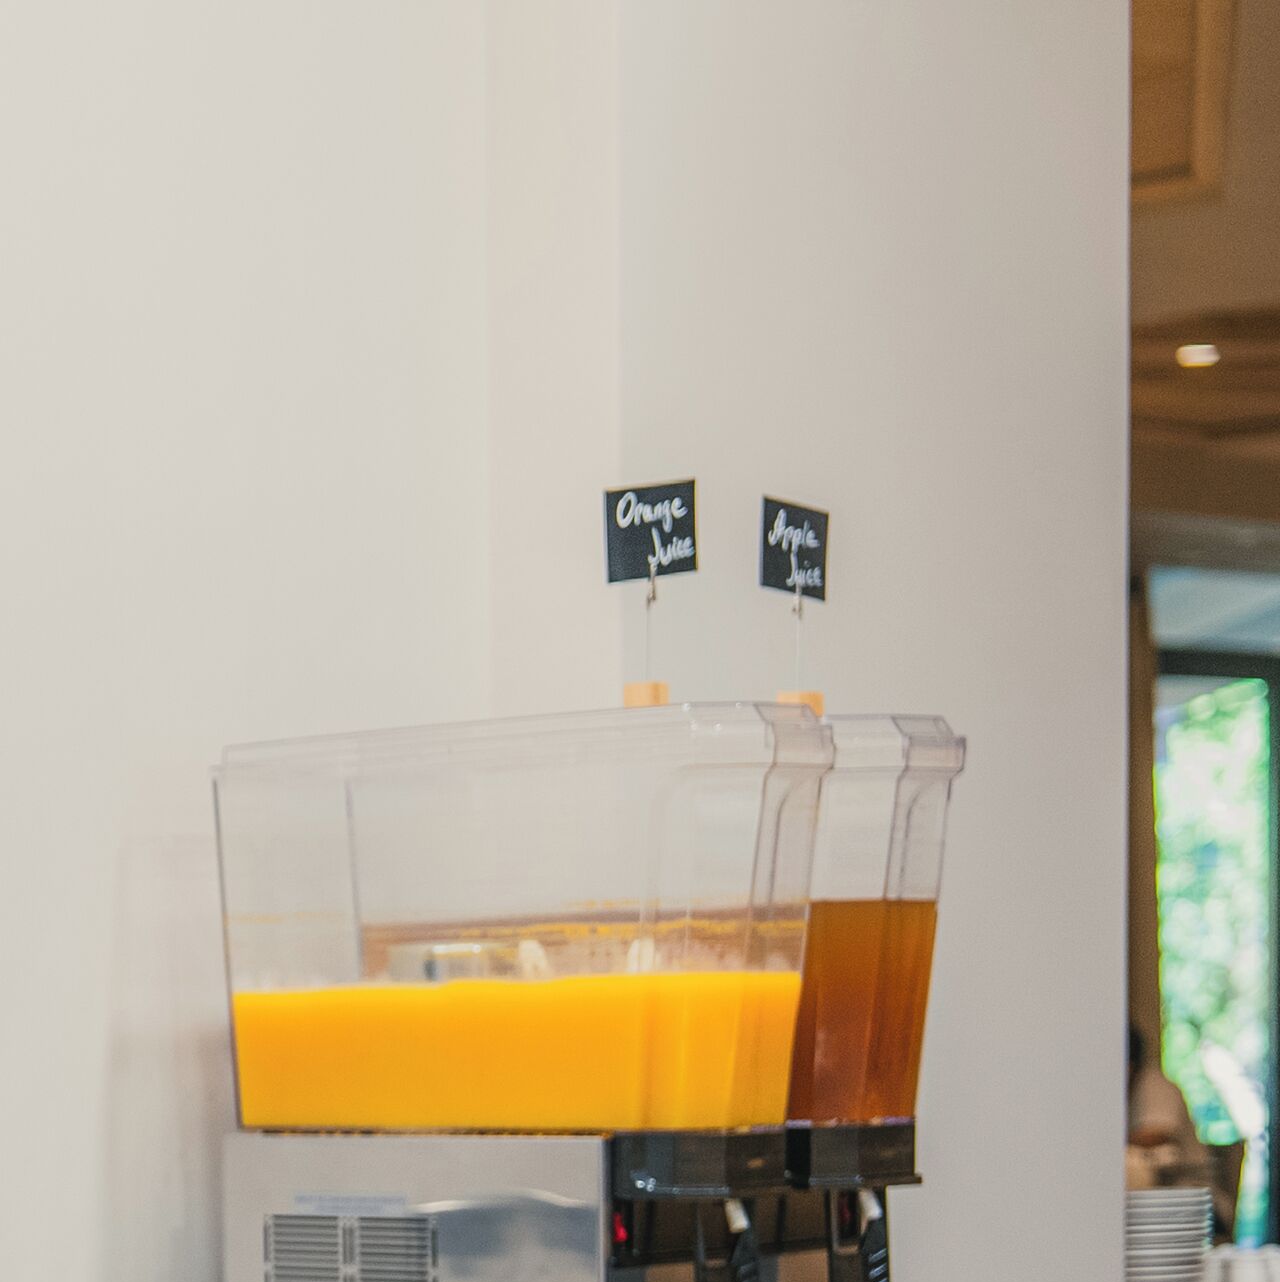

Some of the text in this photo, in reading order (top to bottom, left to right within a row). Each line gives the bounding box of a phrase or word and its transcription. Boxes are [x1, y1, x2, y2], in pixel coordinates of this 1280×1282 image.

[616, 491, 688, 533] Orange
[768, 508, 820, 553] Apple
[648, 526, 695, 566] Juice
[786, 552, 823, 588] Juice
